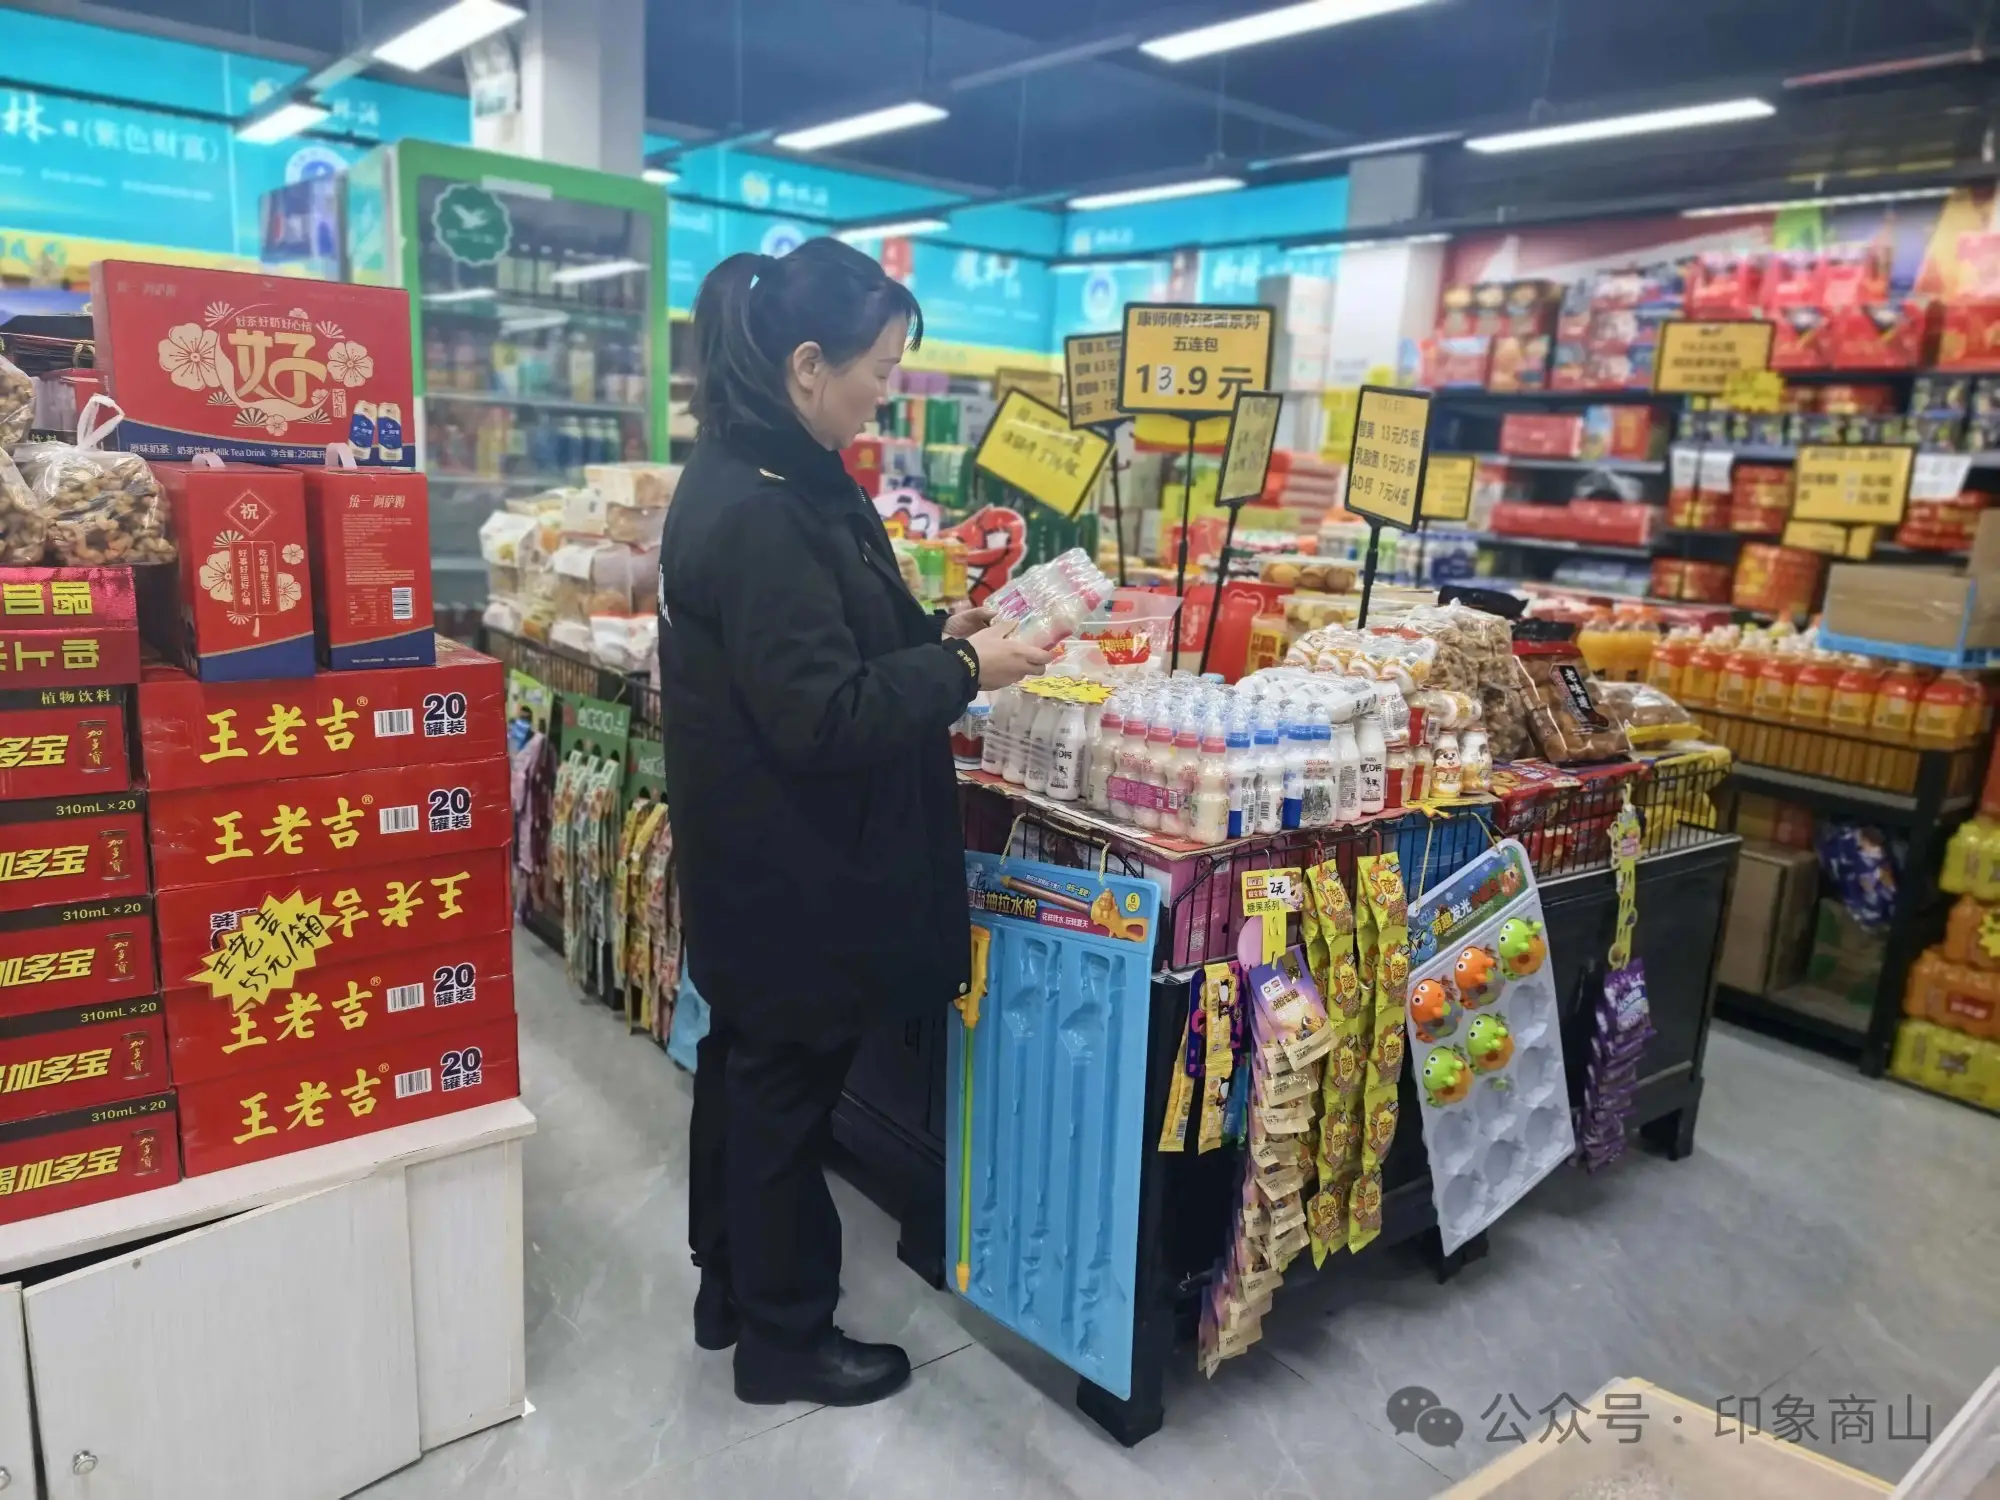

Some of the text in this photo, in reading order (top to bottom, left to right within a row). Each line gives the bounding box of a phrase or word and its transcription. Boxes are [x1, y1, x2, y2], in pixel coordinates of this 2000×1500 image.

[1173, 336, 1219, 353] 五连包
[1136, 364, 1208, 396] 13.9
[1217, 366, 1254, 400] 元
[129, 443, 170, 455] 原味奶茶
[231, 448, 245, 457] Tea
[245, 448, 267, 458] Drink
[240, 503, 259, 520] 祝
[41, 689, 111, 705] 植物饮料
[423, 692, 467, 722] 20
[199, 697, 360, 764] 王老吉
[424, 720, 467, 737] 罐装
[428, 787, 471, 818] 20
[205, 796, 365, 865] 王老吉
[429, 814, 471, 833] 罐装
[1269, 881, 1286, 896] 2元
[1246, 900, 1280, 913] 糖果系列
[212, 908, 283, 979] 王老吉
[433, 963, 476, 994] 20
[435, 988, 476, 1008] 罐装
[221, 981, 373, 1055] 王老吉
[440, 1047, 482, 1078] 20
[441, 1071, 482, 1092] 罐装
[233, 1068, 381, 1145] 王老吉
